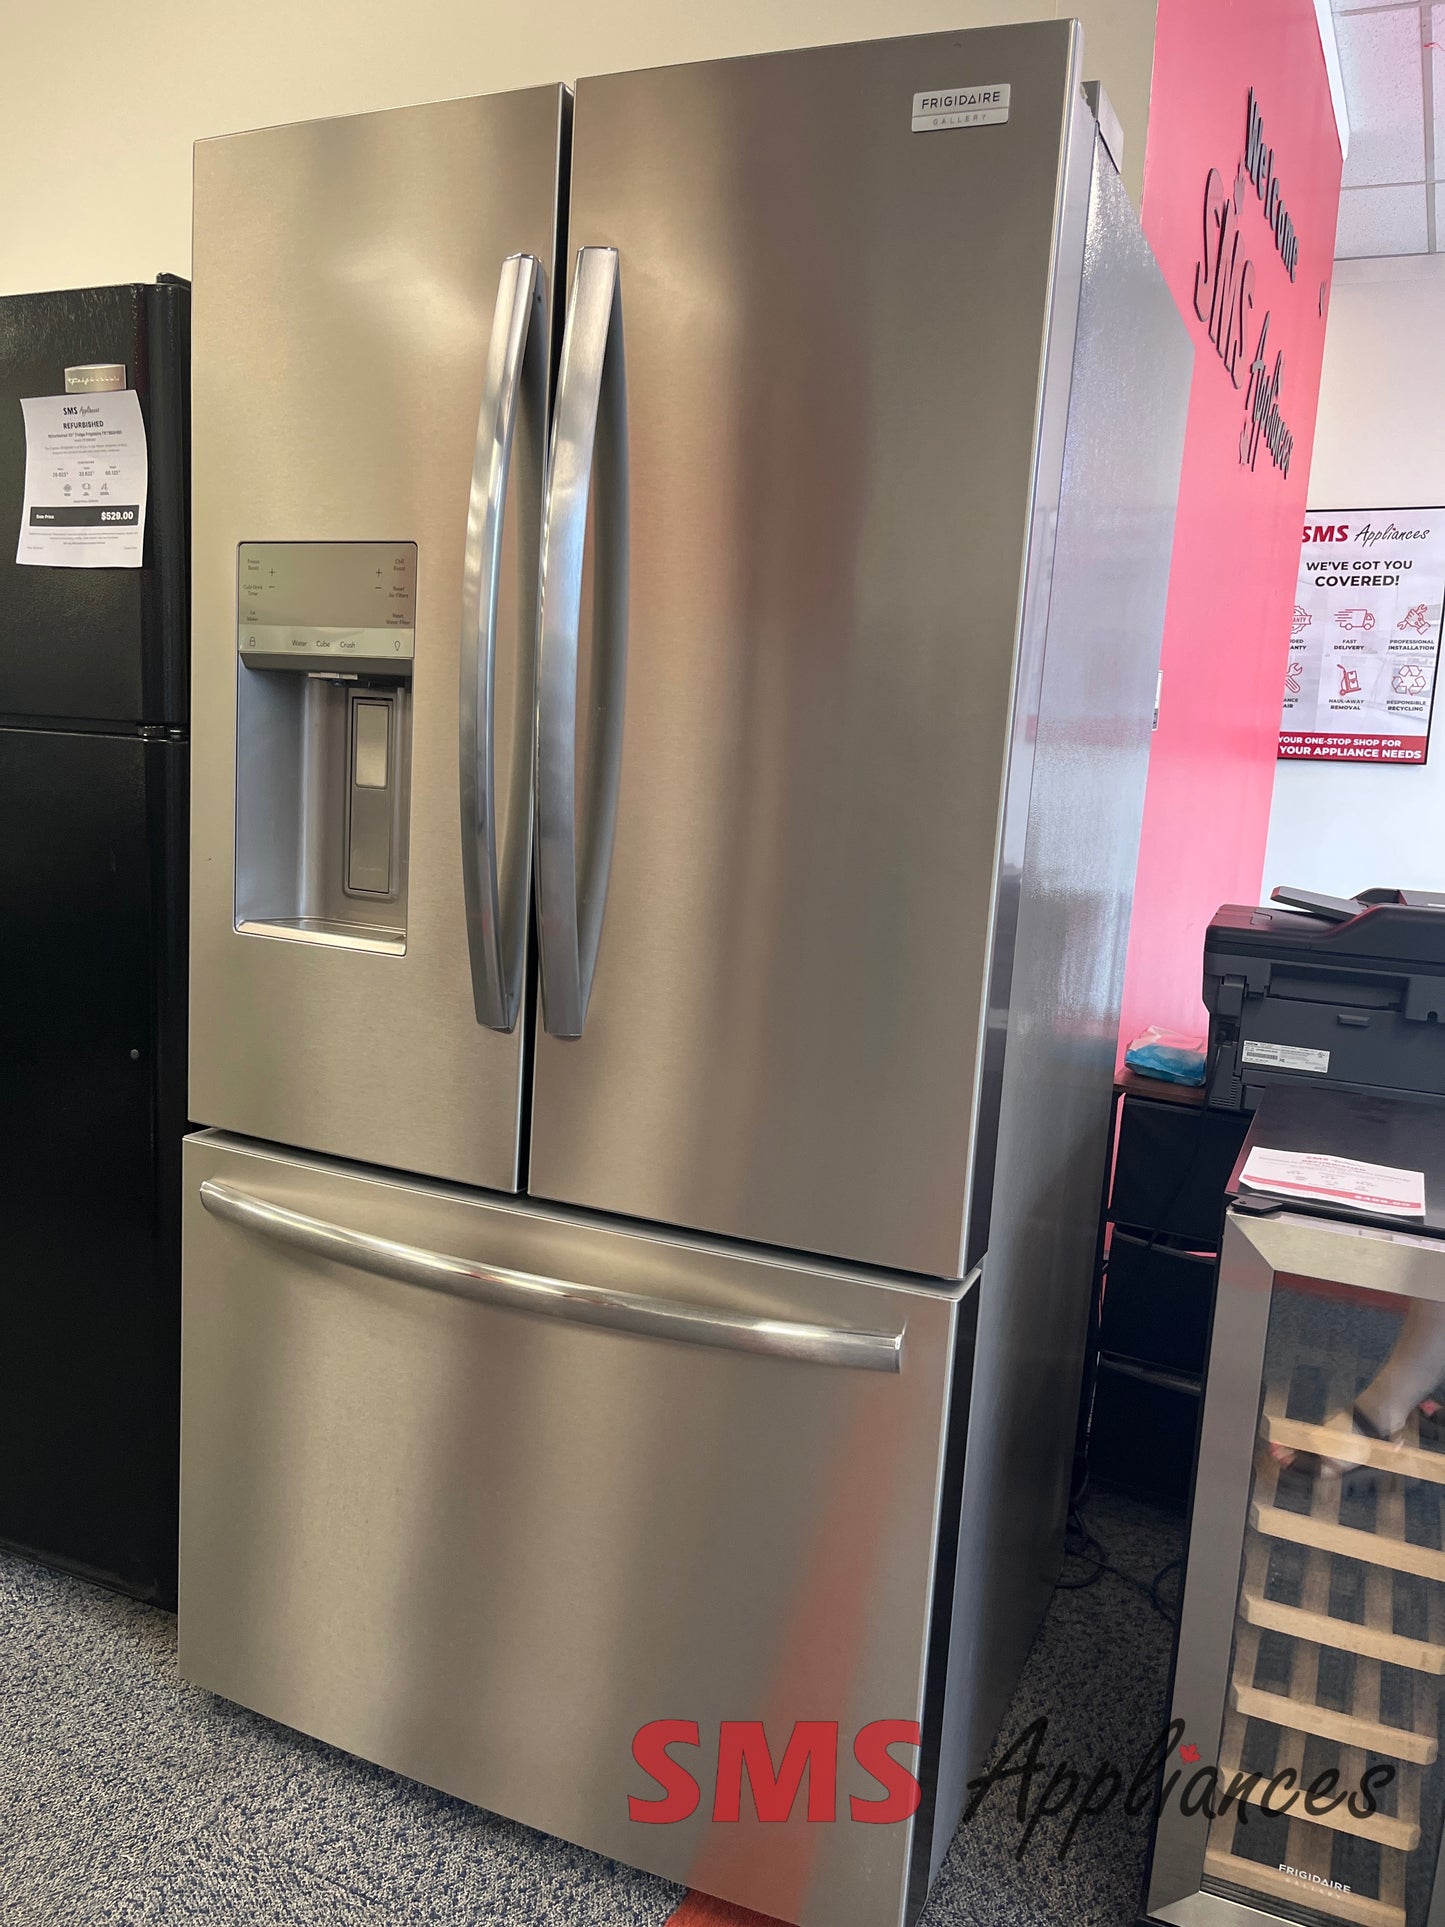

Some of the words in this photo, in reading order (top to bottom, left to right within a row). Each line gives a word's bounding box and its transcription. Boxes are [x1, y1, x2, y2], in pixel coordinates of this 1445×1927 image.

[922, 91, 1000, 109] FRIGIDAIRE
[933, 113, 988, 126] GALLERY
[1244, 86, 1297, 282] Welcome
[1194, 168, 1255, 389] SMS
[63, 406, 78, 415] SMS
[63, 420, 104, 429] REFURBISHED
[101, 511, 134, 521] $529.00
[1302, 525, 1349, 542] SMS
[1354, 524, 1430, 547] Appliances
[1306, 561, 1349, 570] WE'VE
[1352, 561, 1380, 570] GOT
[1384, 560, 1412, 569] YOU
[1315, 575, 1400, 587] COVERED!
[1280, 746, 1311, 755] YOUR
[1313, 747, 1378, 758] APPLIANCE
[1382, 750, 1421, 759] NEEDS
[1278, 1863, 1352, 1894] FRIGIDAIRE
